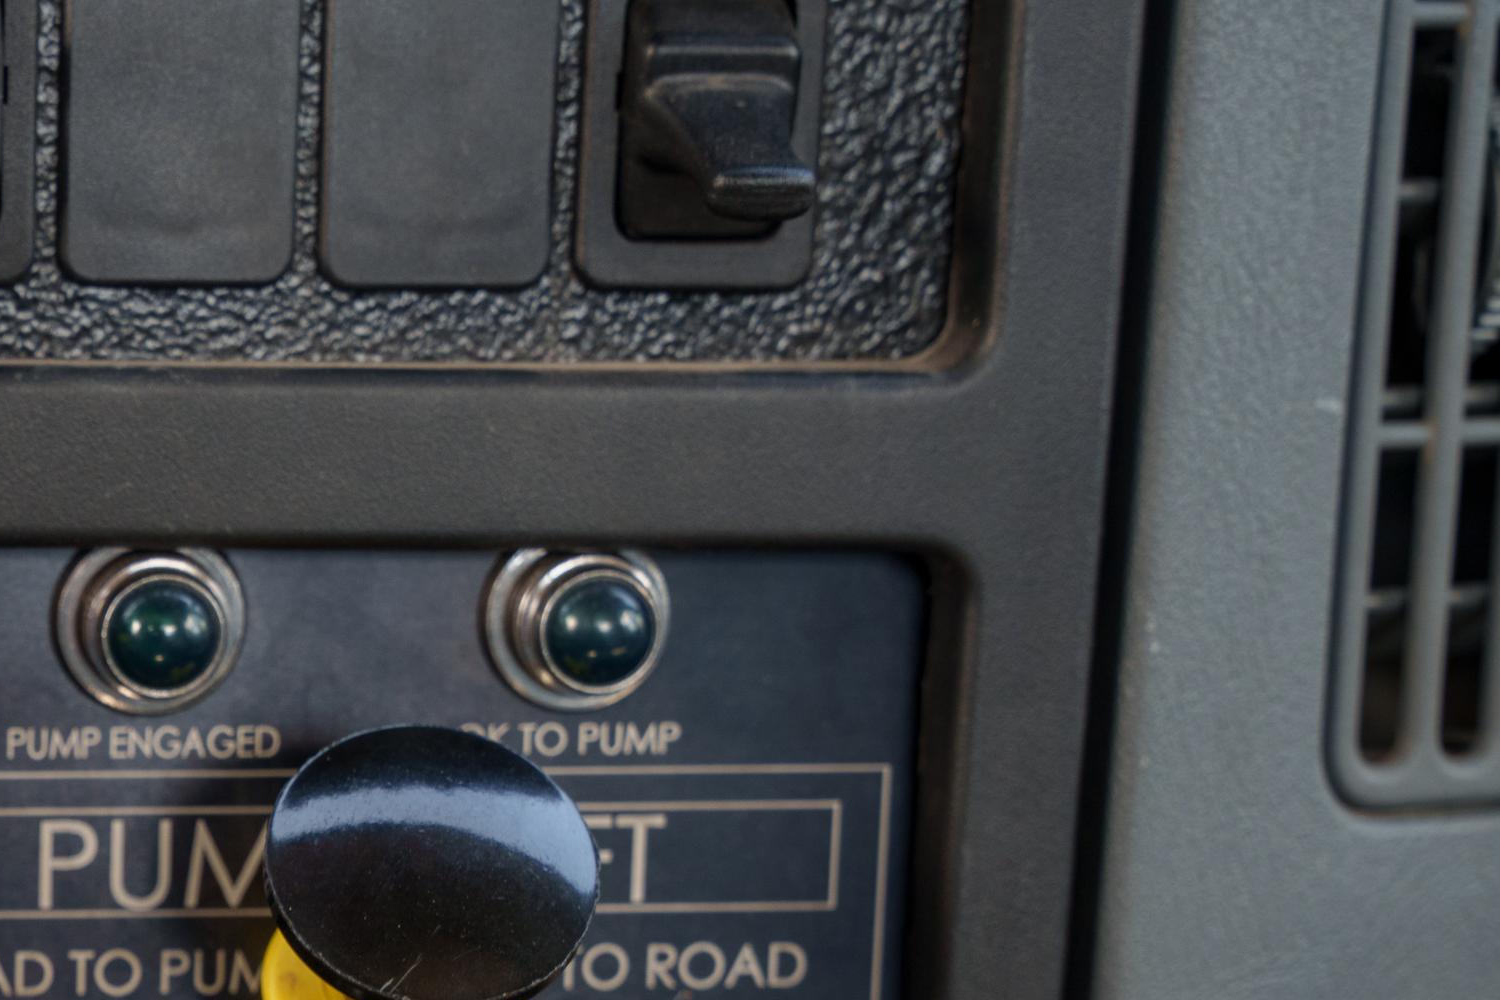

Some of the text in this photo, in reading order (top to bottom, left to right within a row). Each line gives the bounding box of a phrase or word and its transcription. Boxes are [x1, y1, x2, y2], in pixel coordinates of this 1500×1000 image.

[6, 725, 281, 760] PUMP ENGAGED
[517, 721, 569, 757] TO
[577, 721, 683, 756] PUMP
[38, 819, 268, 911] PUM
[69, 948, 143, 997] TO
[159, 948, 261, 995] PUM
[645, 940, 808, 991] ROAD
